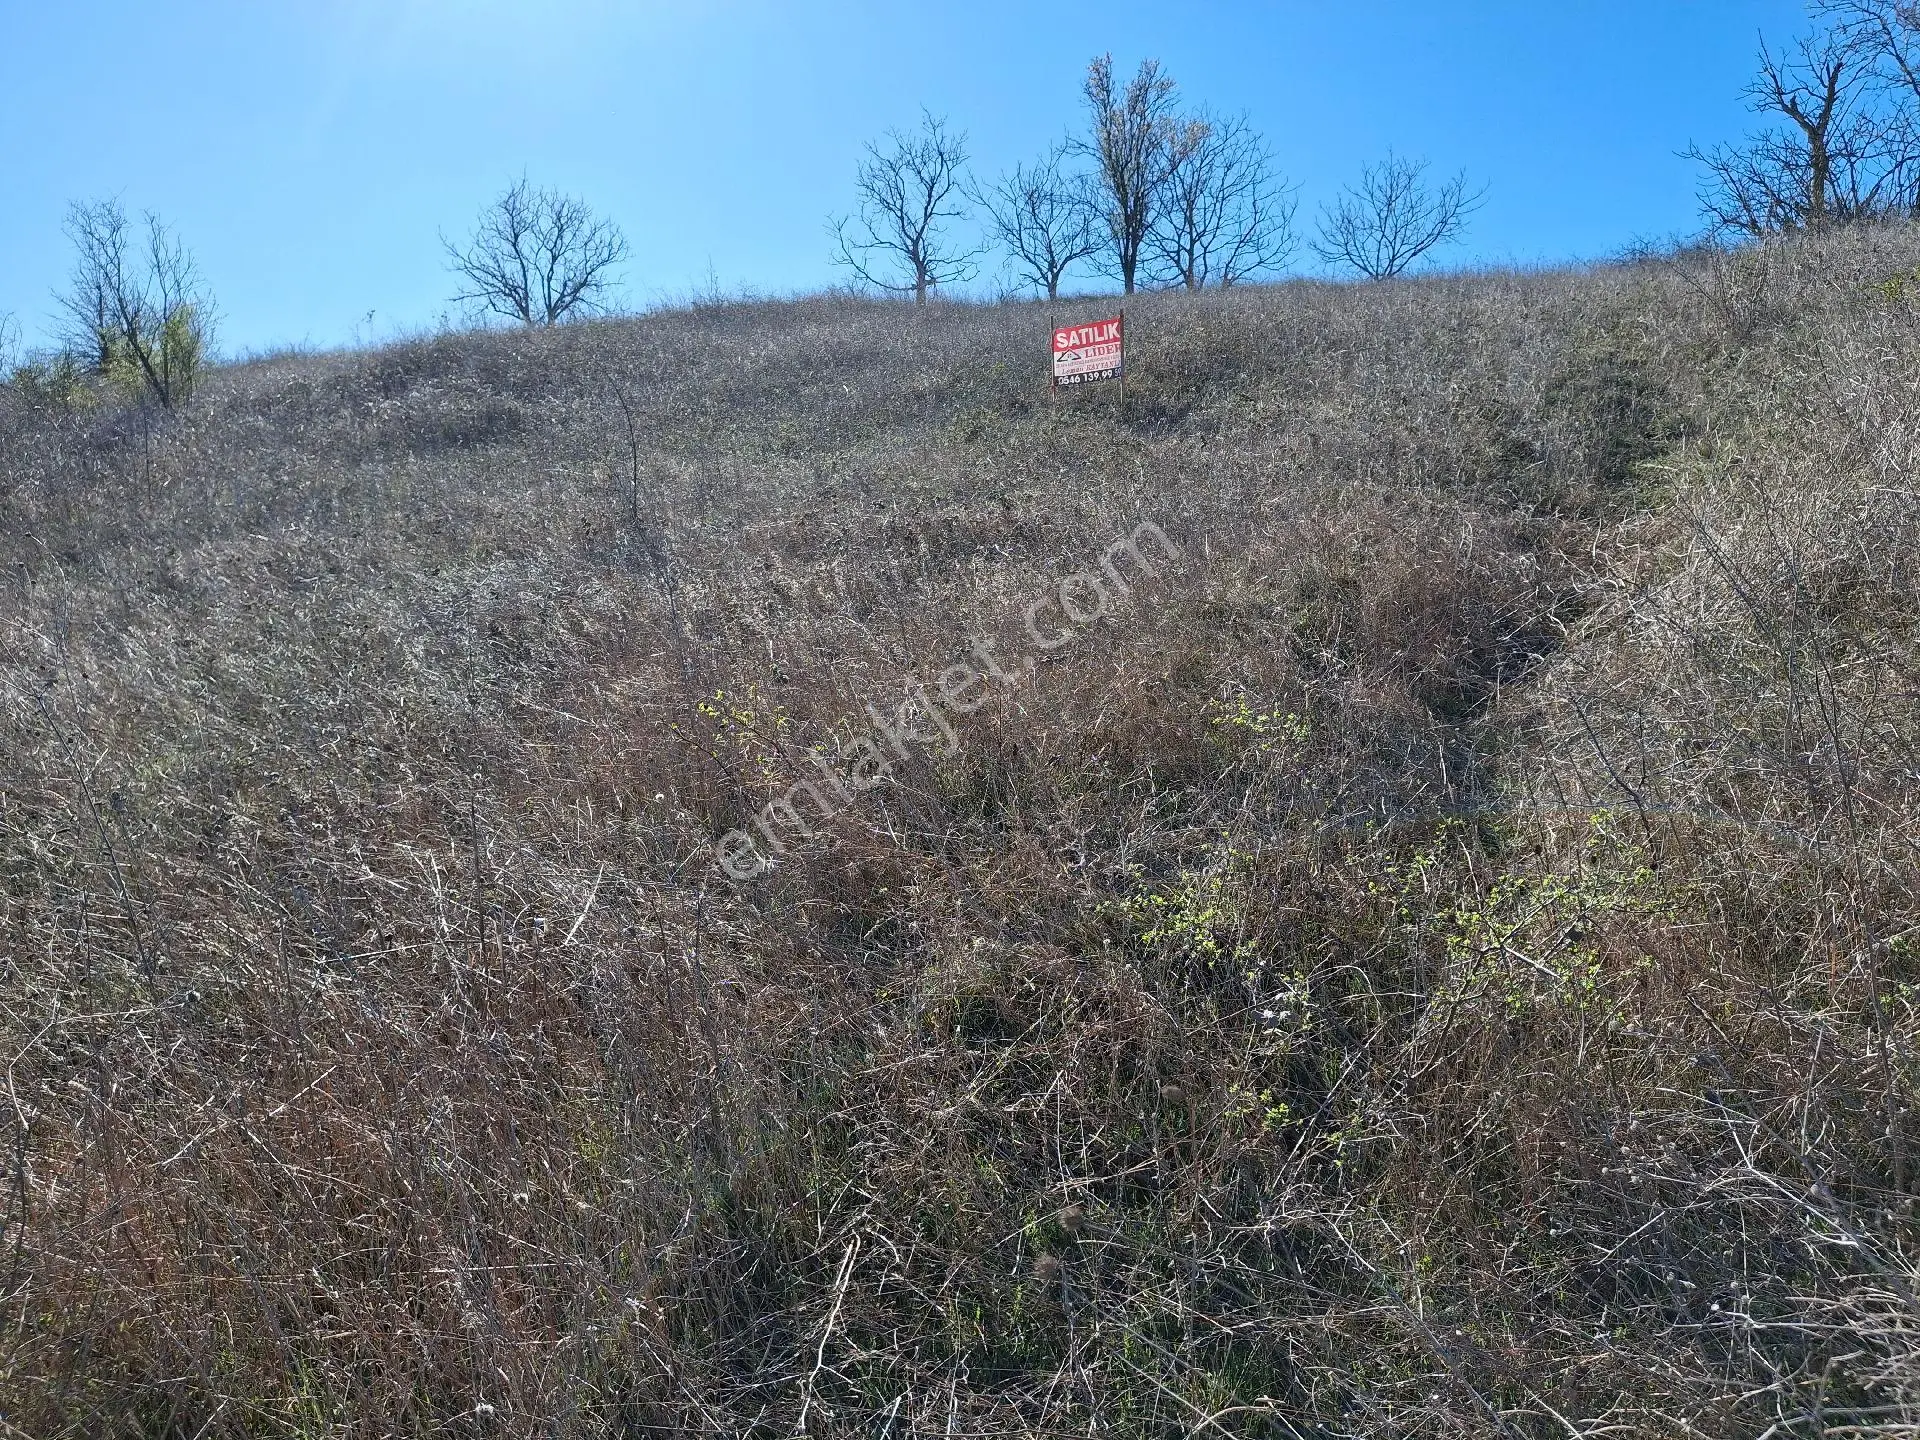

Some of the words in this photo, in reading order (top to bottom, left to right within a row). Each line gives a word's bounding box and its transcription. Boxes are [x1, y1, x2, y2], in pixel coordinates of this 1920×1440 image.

[1056, 322, 1120, 348] SATILIK
[1058, 375, 1080, 385] 0546
[1083, 371, 1099, 382] 139
[1102, 370, 1113, 379] 99
